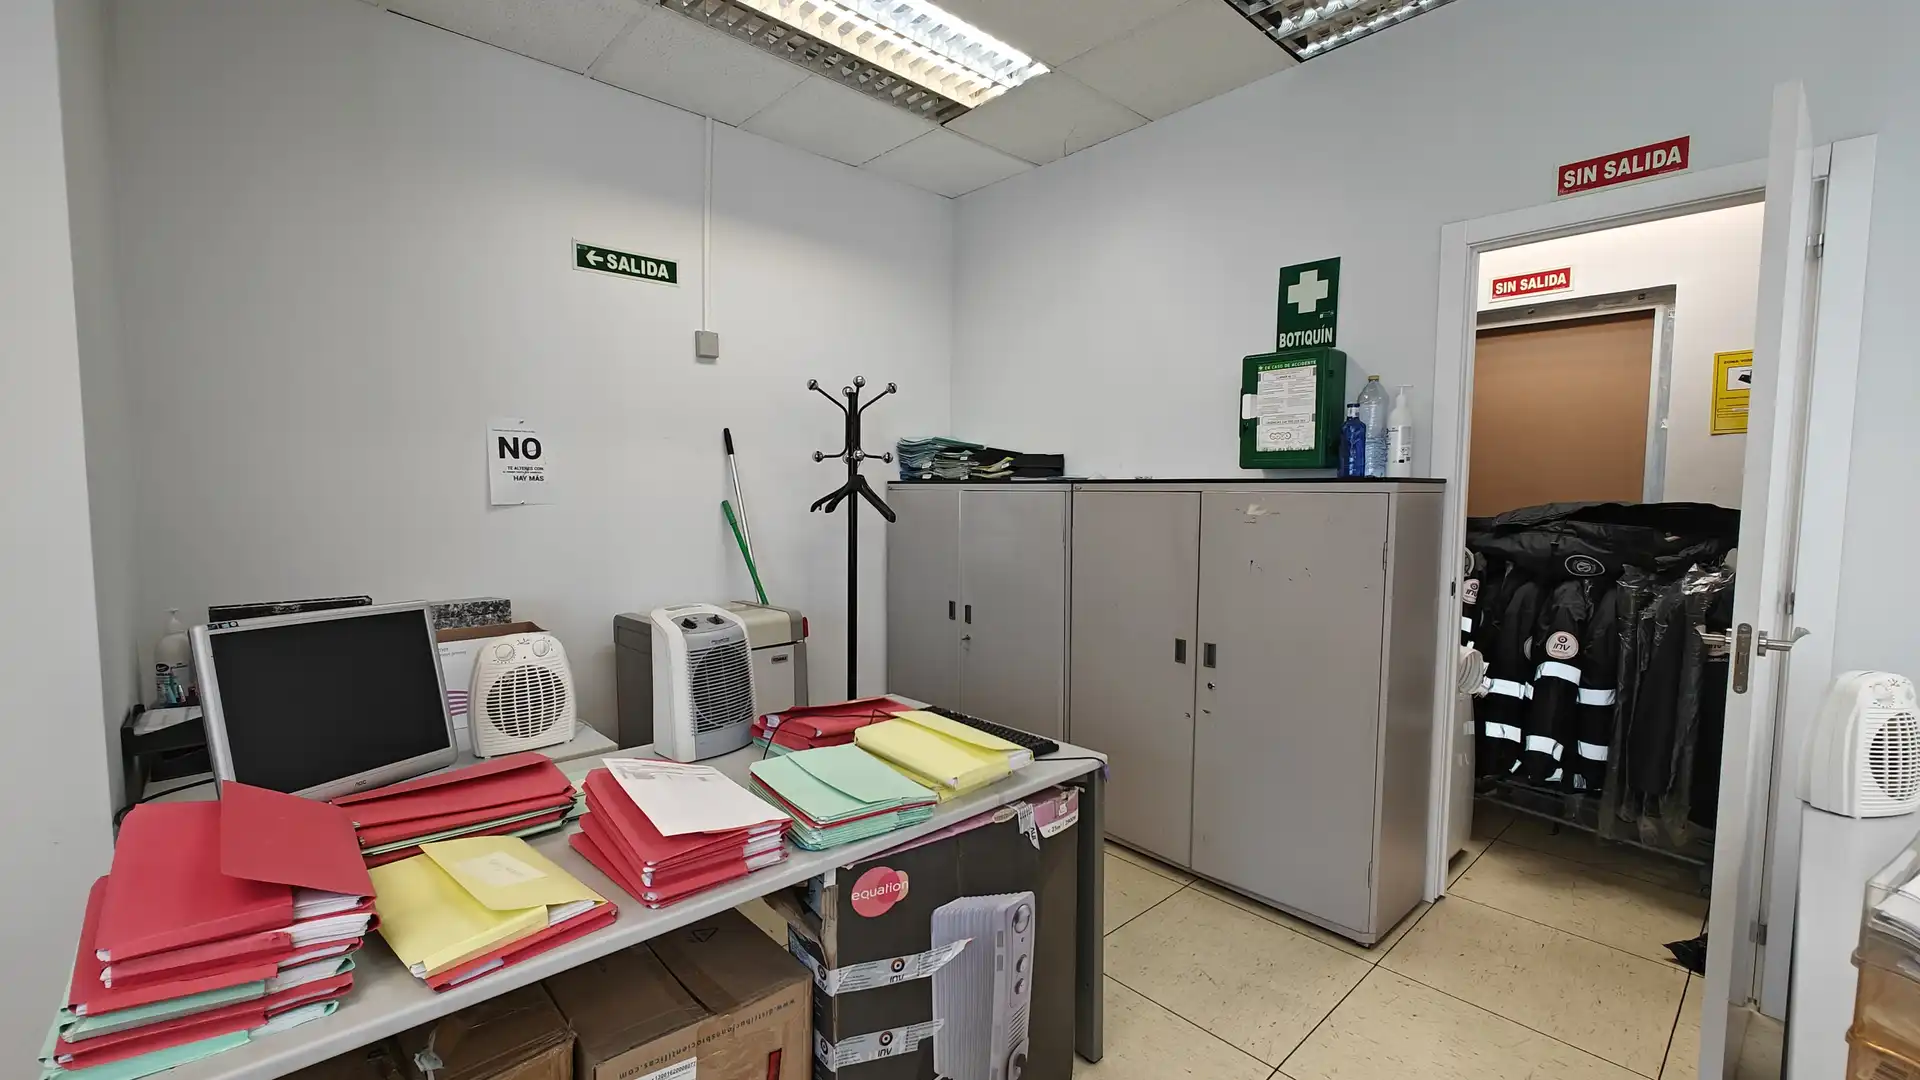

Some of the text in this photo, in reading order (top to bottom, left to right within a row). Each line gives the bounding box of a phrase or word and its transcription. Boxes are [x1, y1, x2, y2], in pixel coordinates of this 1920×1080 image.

[1563, 145, 1682, 188] SIN SALIDA
[606, 253, 670, 279] SALIDA
[1495, 272, 1567, 295] SIN SALIDA
[1279, 324, 1333, 348] BOTIQUÍN
[498, 436, 542, 460] NO
[851, 880, 909, 901] equation
